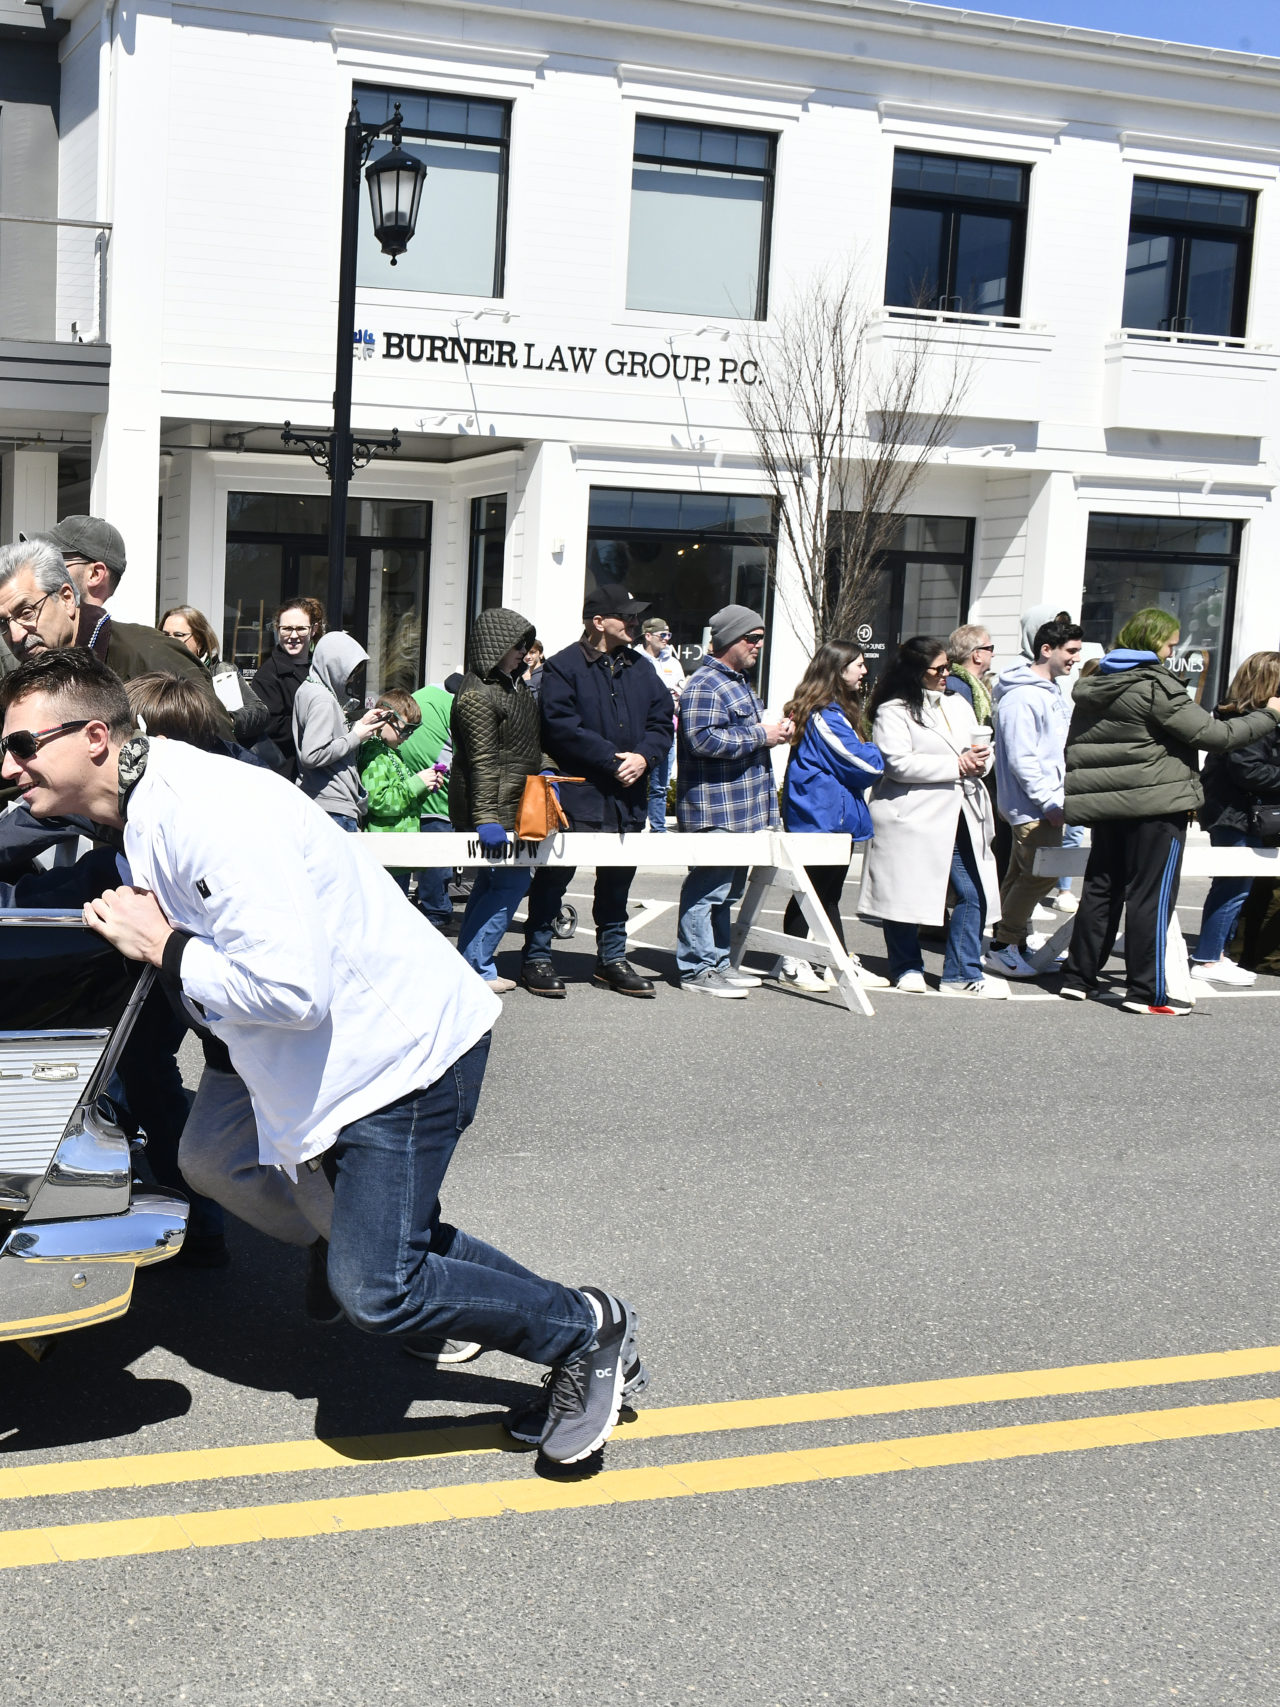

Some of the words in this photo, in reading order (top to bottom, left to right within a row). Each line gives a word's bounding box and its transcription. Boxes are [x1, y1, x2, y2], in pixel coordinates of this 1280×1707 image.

[382, 331, 518, 370] BURNER
[522, 343, 598, 375] LAW
[604, 348, 712, 384] GROUP,
[718, 358, 764, 387] P.C.
